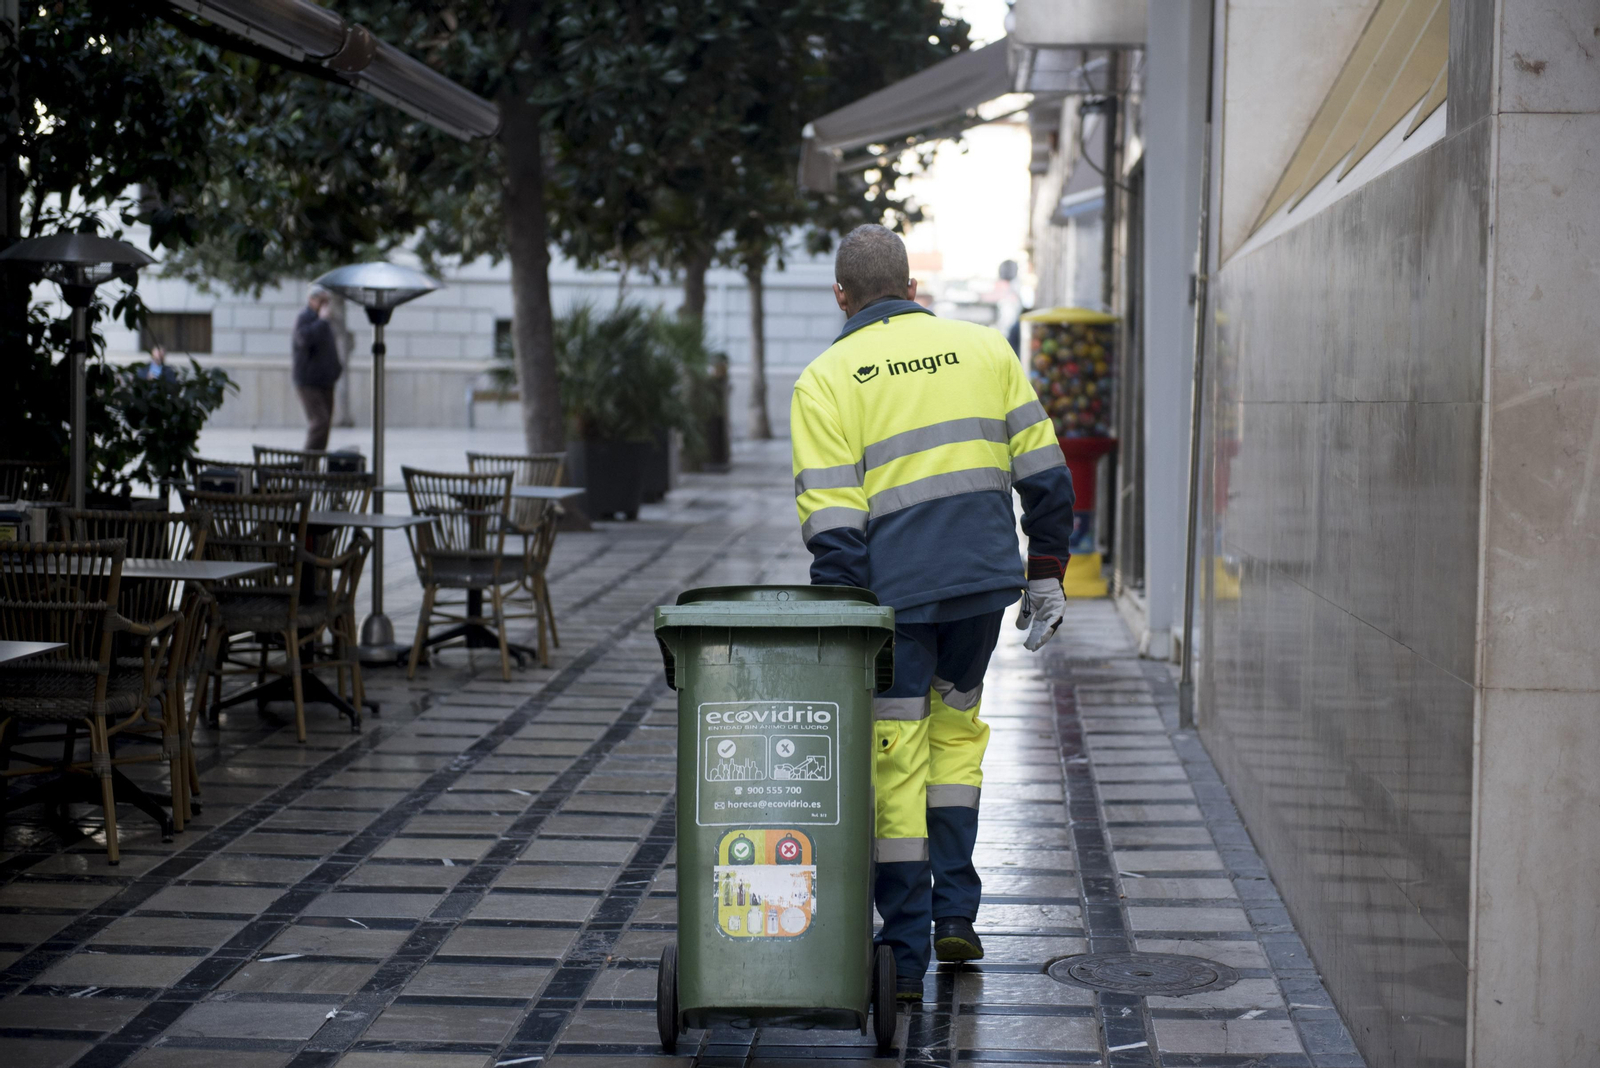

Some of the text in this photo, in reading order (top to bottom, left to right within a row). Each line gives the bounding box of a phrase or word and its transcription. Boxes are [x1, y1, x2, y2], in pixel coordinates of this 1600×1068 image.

[886, 352, 960, 375] inagra
[705, 705, 832, 724] ecovidrio
[747, 786, 802, 794] 900 555 700
[727, 800, 821, 809] horeca@ecovidrio.es
